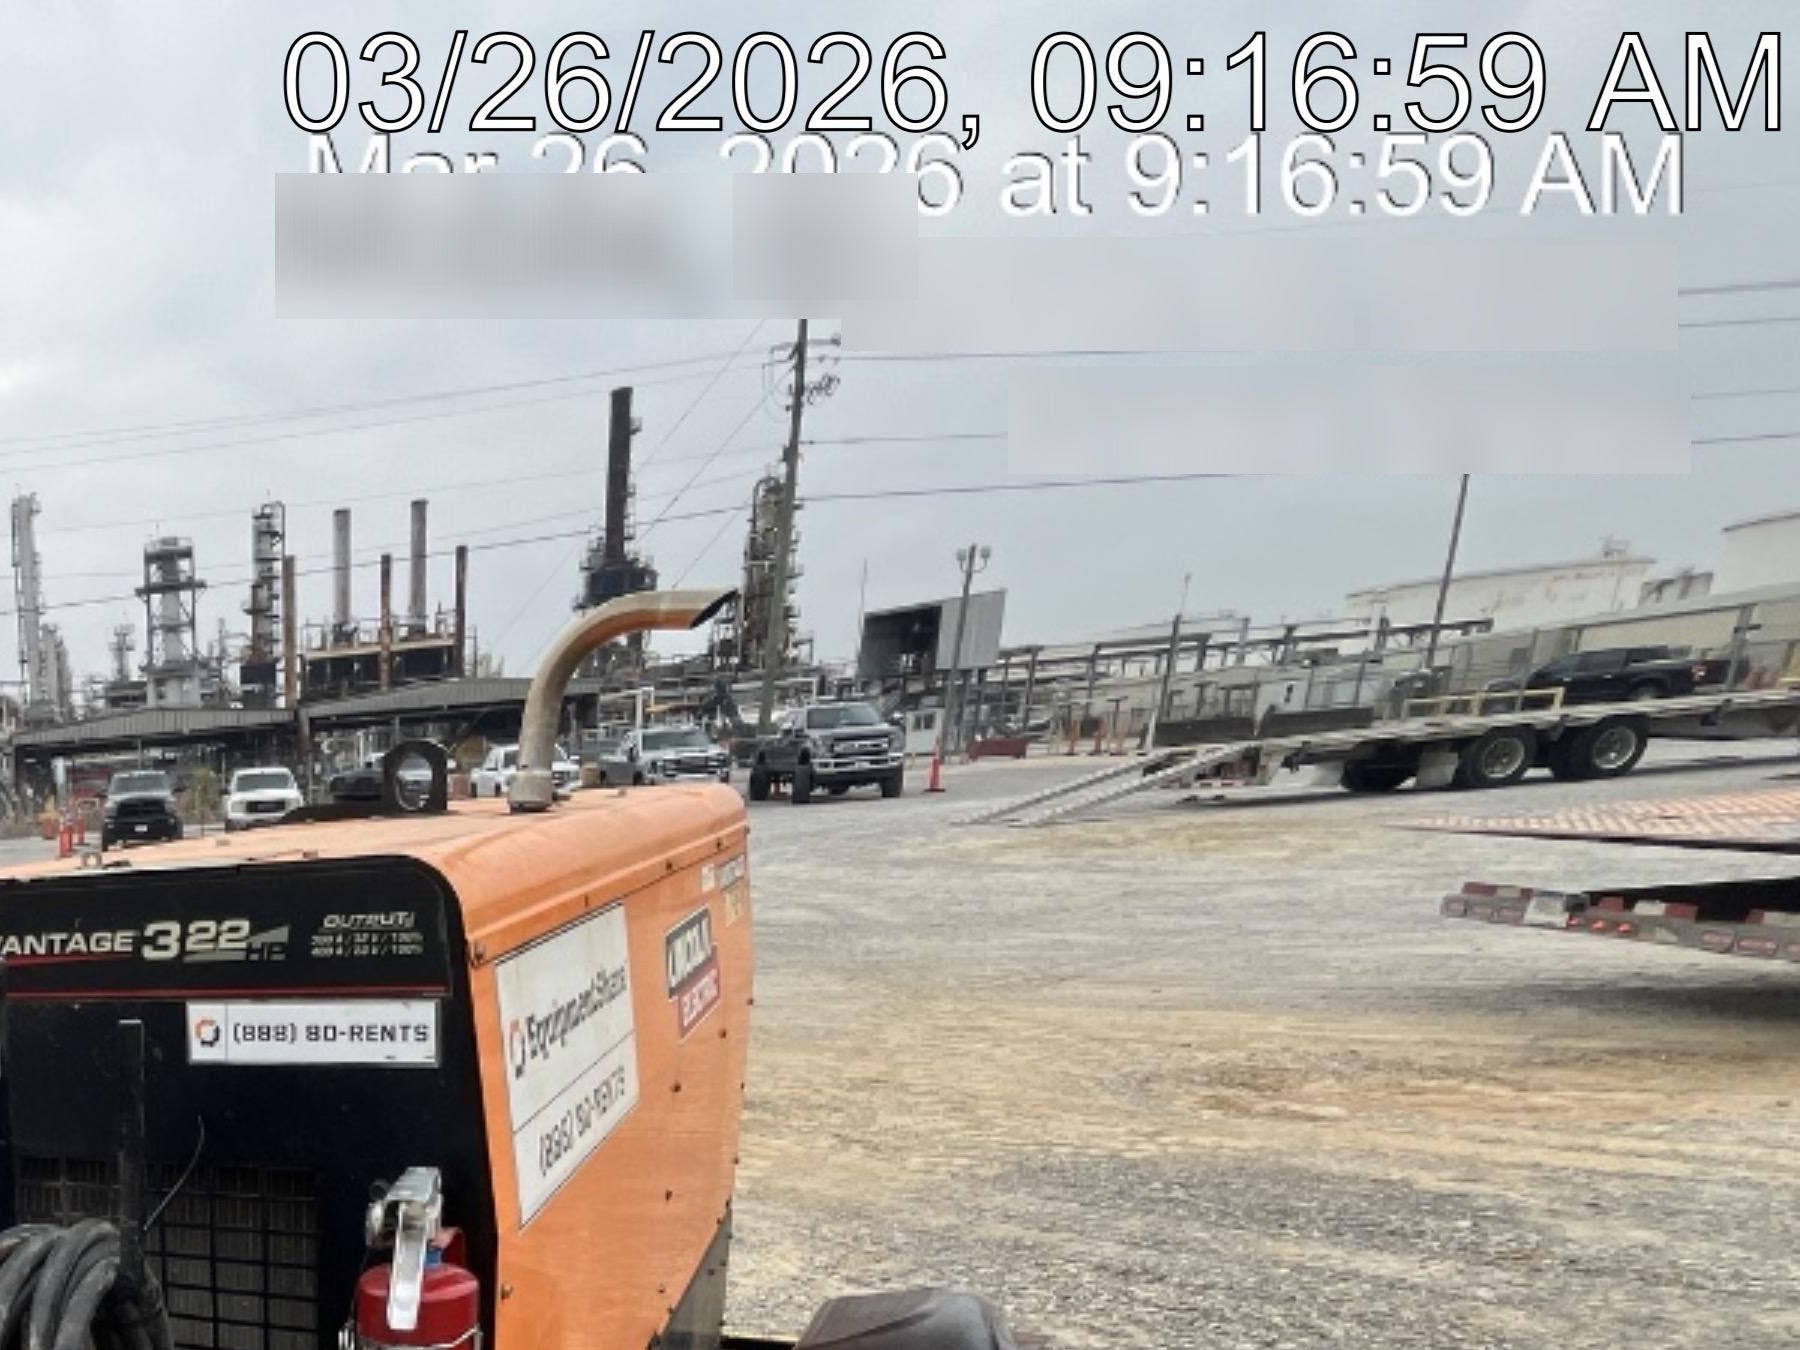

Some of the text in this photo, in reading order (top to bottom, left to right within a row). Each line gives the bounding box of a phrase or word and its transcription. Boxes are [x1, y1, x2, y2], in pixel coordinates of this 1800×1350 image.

[142, 919, 251, 961] 322
[233, 1022, 430, 1043] (888) 80-RENTS
